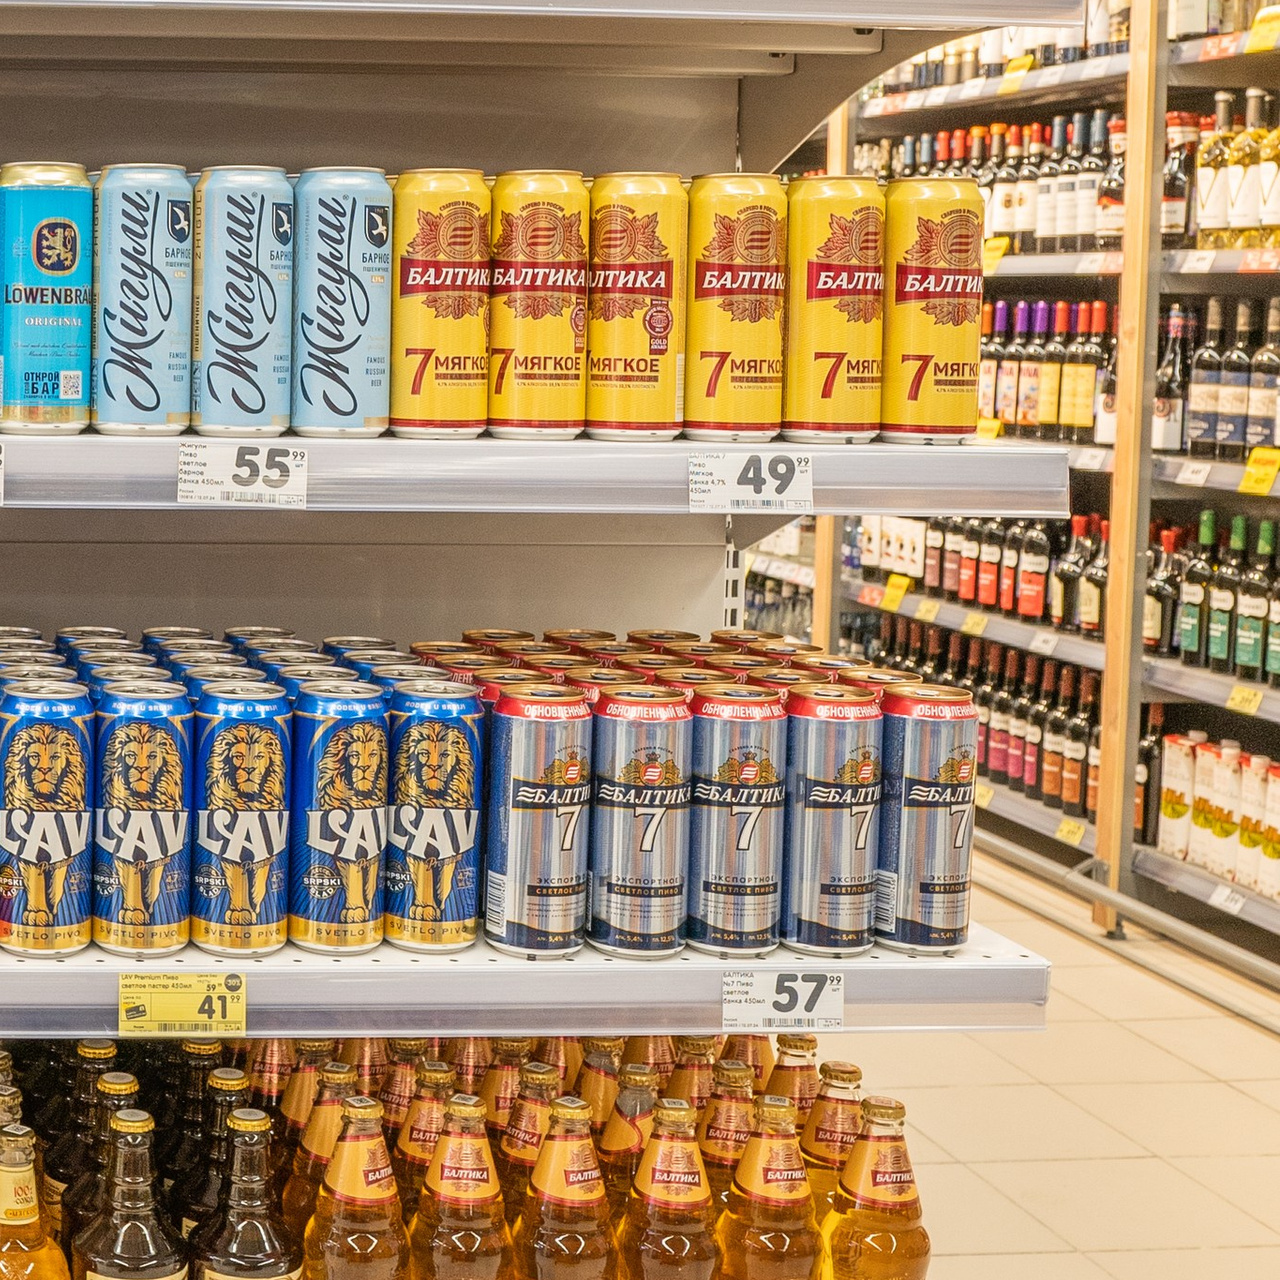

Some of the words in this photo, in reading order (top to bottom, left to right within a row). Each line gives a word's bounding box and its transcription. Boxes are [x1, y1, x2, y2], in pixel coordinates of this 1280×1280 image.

[362, 253, 389, 264] БАРНОЕ
[493, 269, 585, 285] БАЛТИКА
[102, 191, 171, 411] Жигули
[491, 348, 515, 395] 7
[514, 357, 581, 371] МЯГКОЕ
[231, 446, 290, 489] 55
[292, 451, 306, 460] 99
[737, 455, 796, 494] 49
[797, 458, 809, 466] 99
[702, 702, 772, 718] ОБНОВЛЕННЫЙ
[710, 784, 786, 801] БАЛТИКА
[198, 811, 289, 864] LAV
[731, 806, 764, 851] 7
[195, 876, 225, 886] SRPSKI
[204, 928, 251, 939] SVETLO
[258, 928, 281, 939] PIVO
[772, 973, 828, 1013] 57
[829, 976, 841, 984] 99
[198, 995, 227, 1020] 41
[443, 1169, 488, 1180] БАЛТИКА
